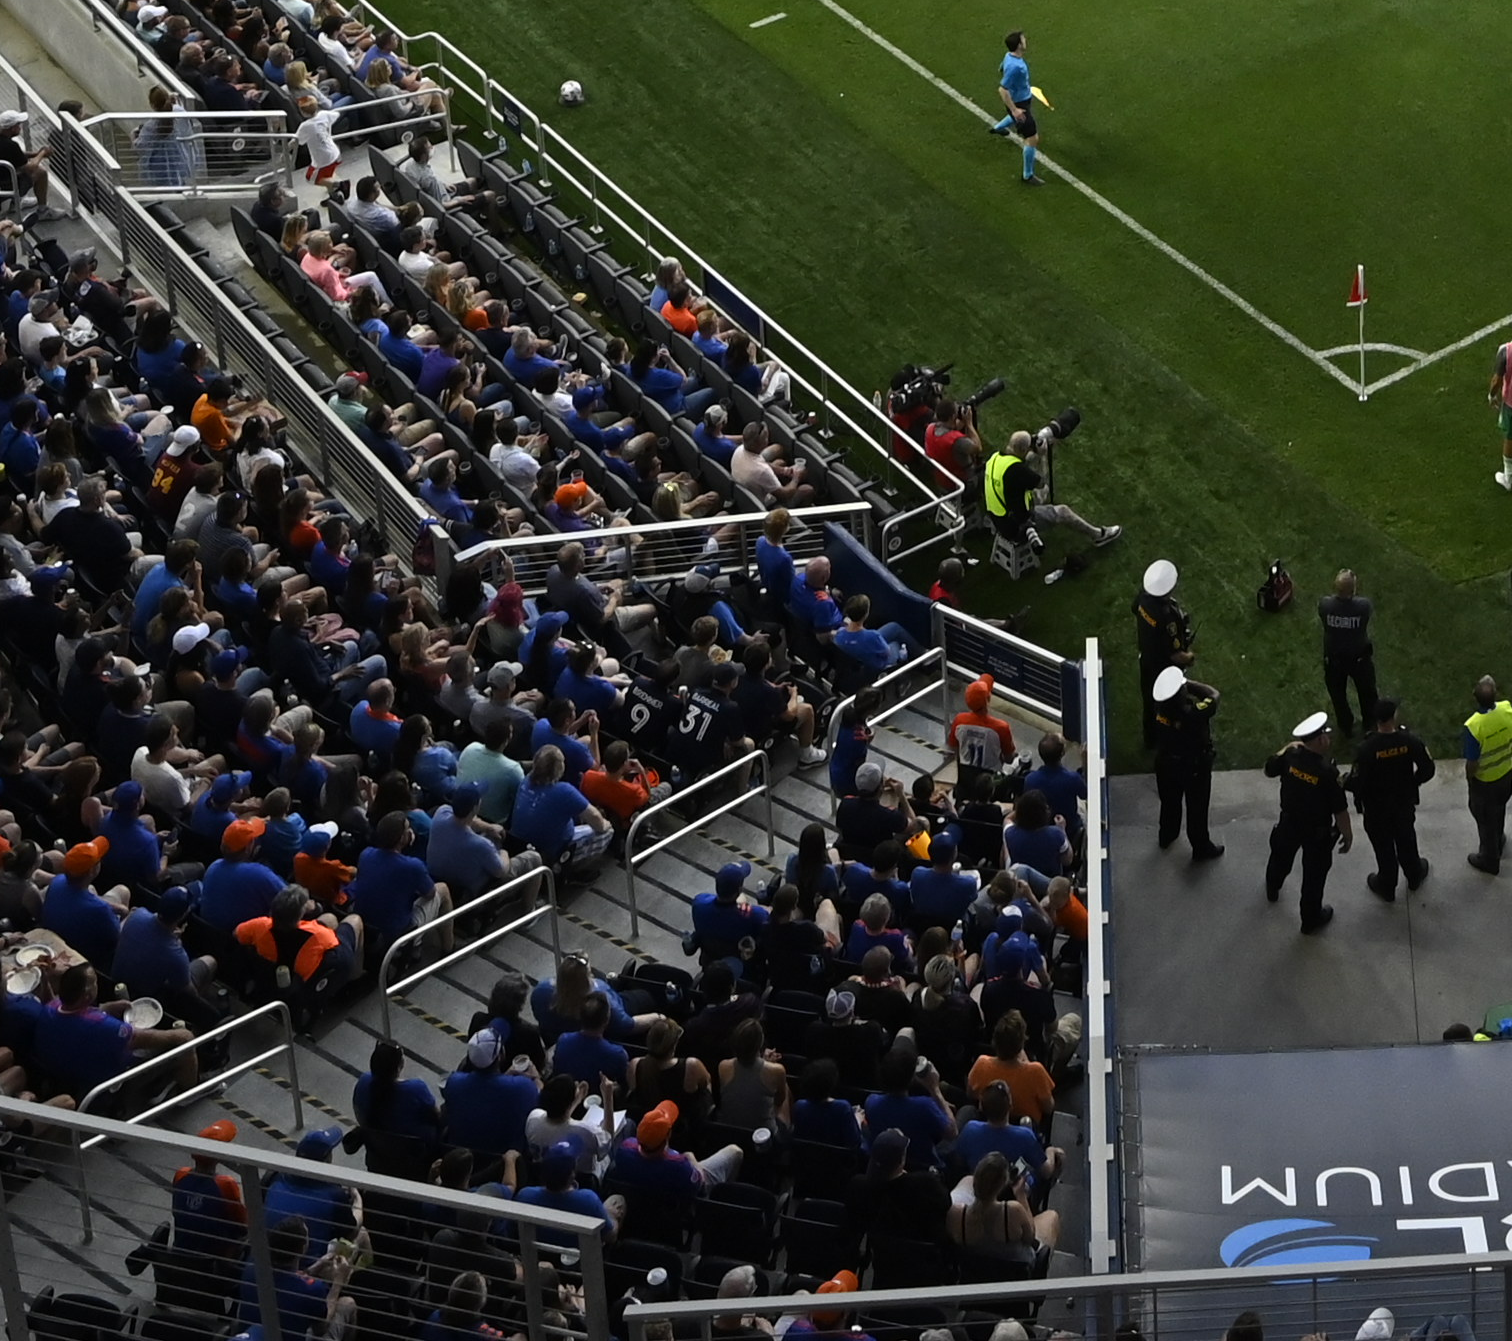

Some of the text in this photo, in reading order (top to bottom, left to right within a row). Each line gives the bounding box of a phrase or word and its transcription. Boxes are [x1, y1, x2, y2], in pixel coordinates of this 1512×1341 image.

[1326, 614, 1362, 629] SECURITY
[630, 703, 650, 734] 9
[679, 704, 712, 741] 31
